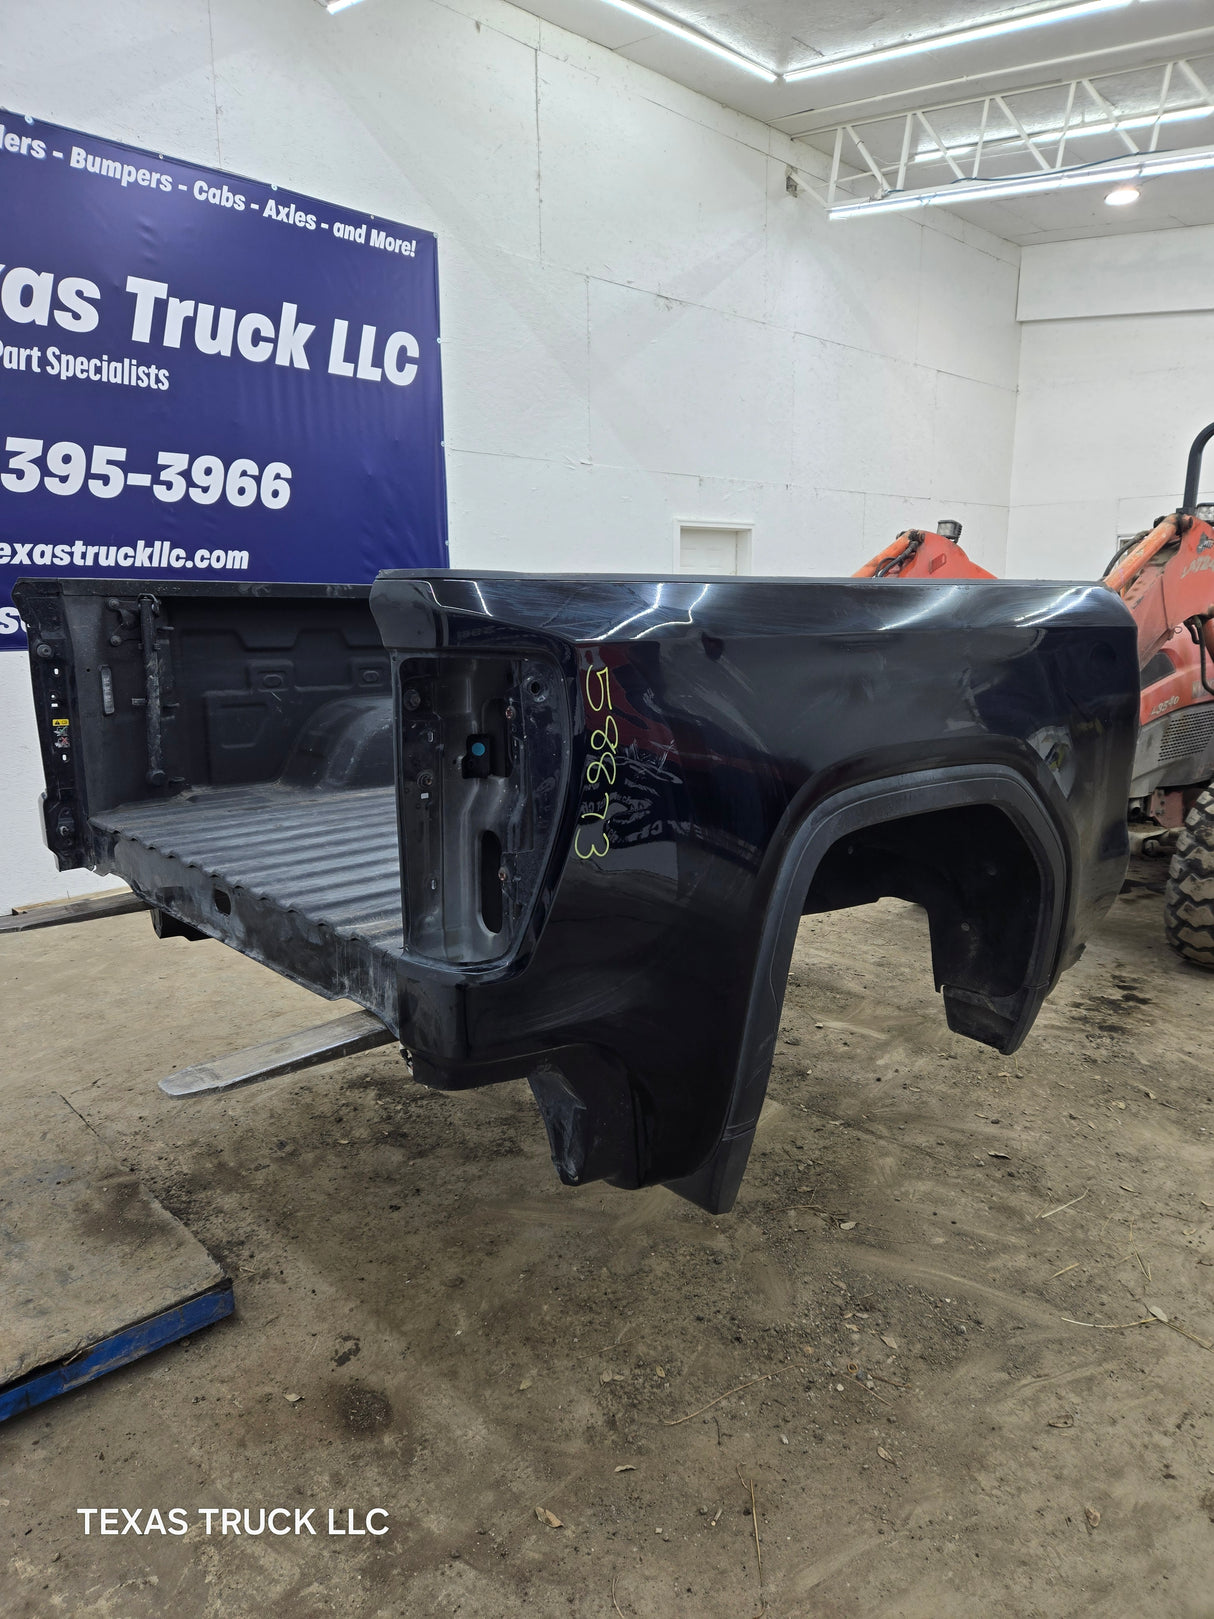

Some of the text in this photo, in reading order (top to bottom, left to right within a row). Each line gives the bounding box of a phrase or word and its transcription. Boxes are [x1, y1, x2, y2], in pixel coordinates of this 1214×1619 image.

[69, 146, 173, 192] Bumpers
[192, 179, 246, 211] Cabs
[262, 198, 317, 230] Axles
[332, 221, 367, 245] and
[369, 228, 417, 258] More!
[0, 264, 420, 387] as Truck LLC
[45, 345, 170, 391] Specialists
[0, 436, 292, 510] 395-3966
[574, 664, 619, 859] 58873
